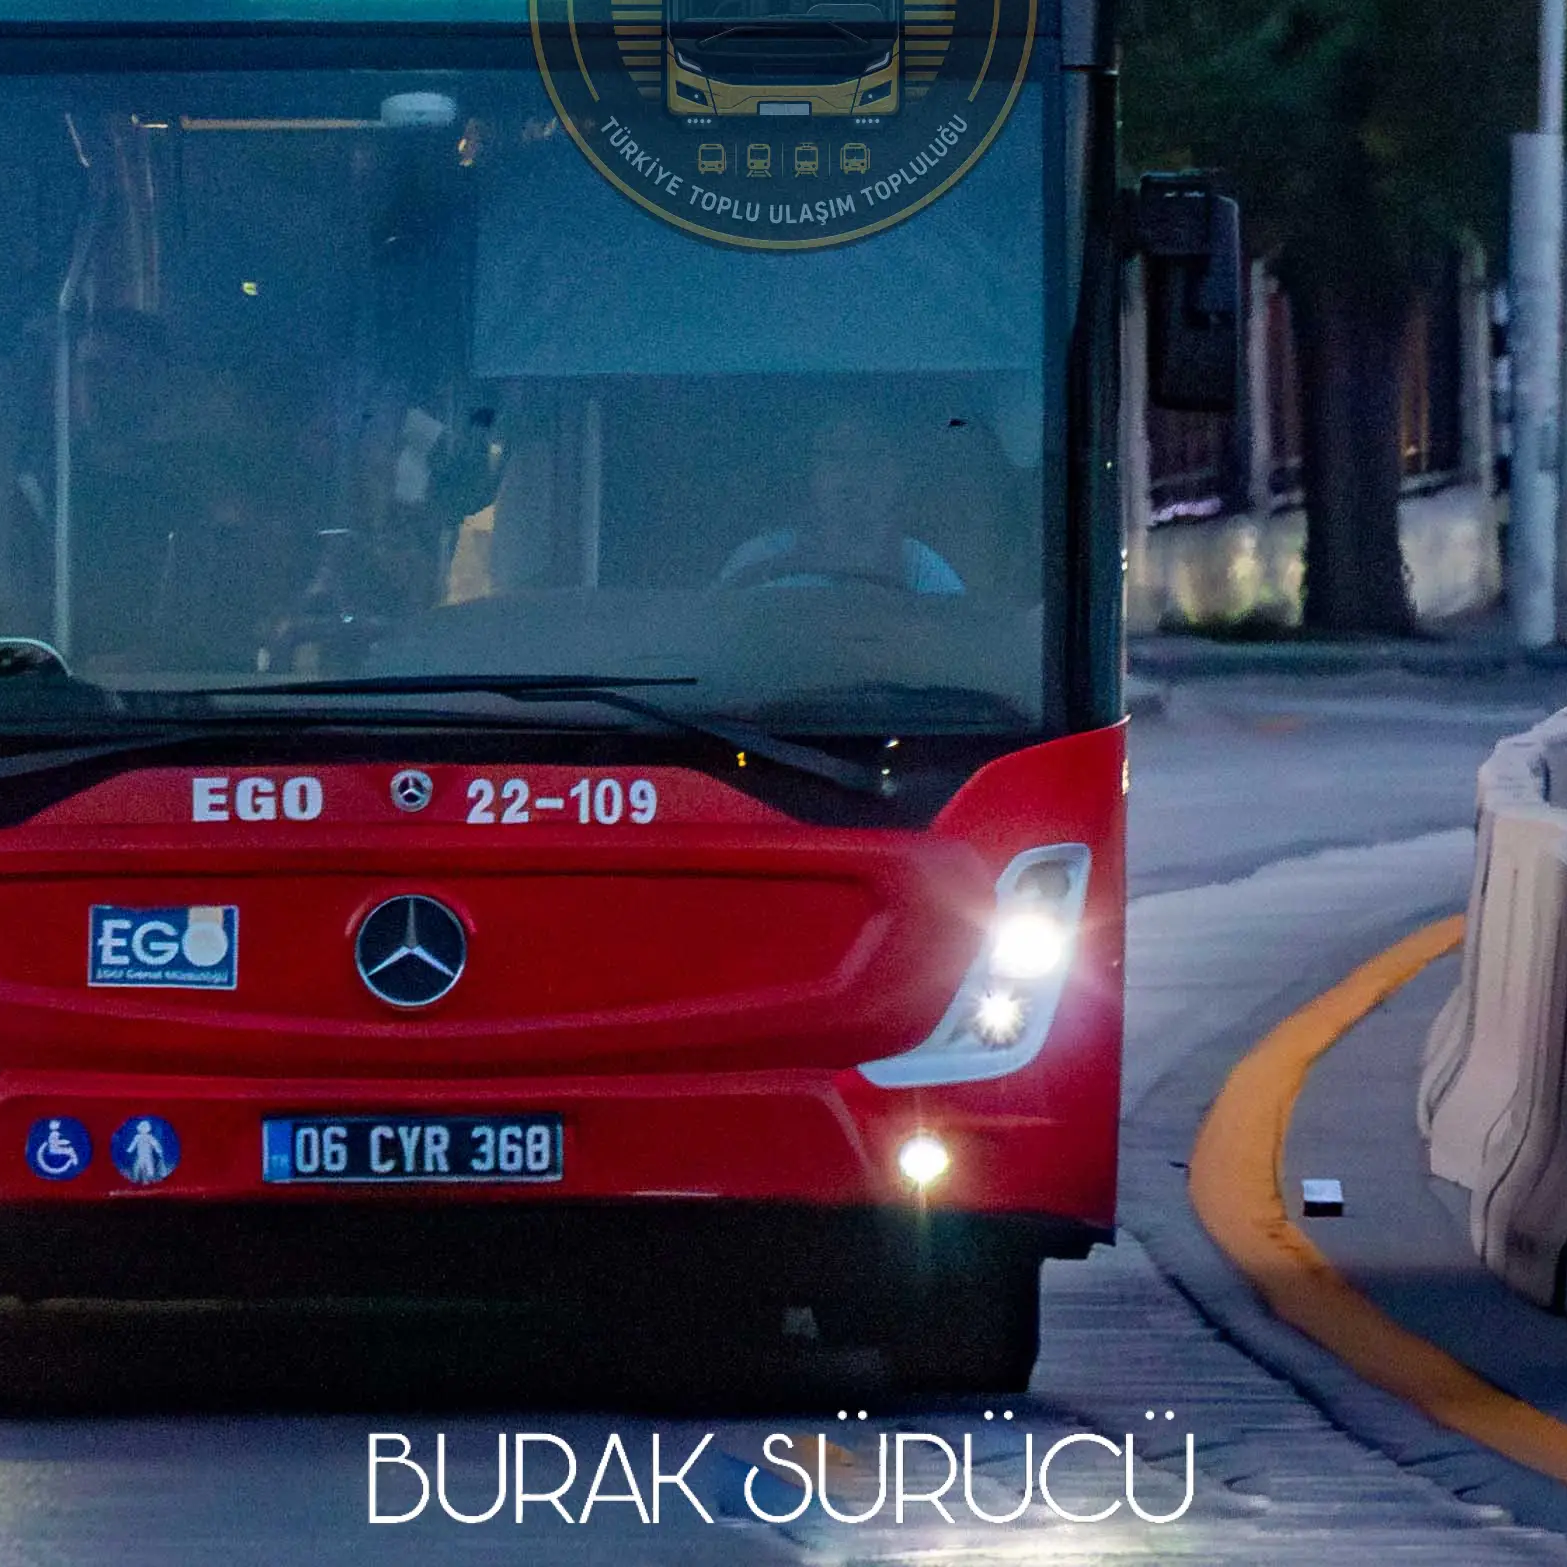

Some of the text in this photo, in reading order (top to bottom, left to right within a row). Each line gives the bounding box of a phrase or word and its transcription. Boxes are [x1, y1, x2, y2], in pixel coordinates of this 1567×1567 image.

[192, 776, 324, 822] EGO
[466, 778, 658, 825] 22-109
[295, 1124, 551, 1173] 06 CYR 368
